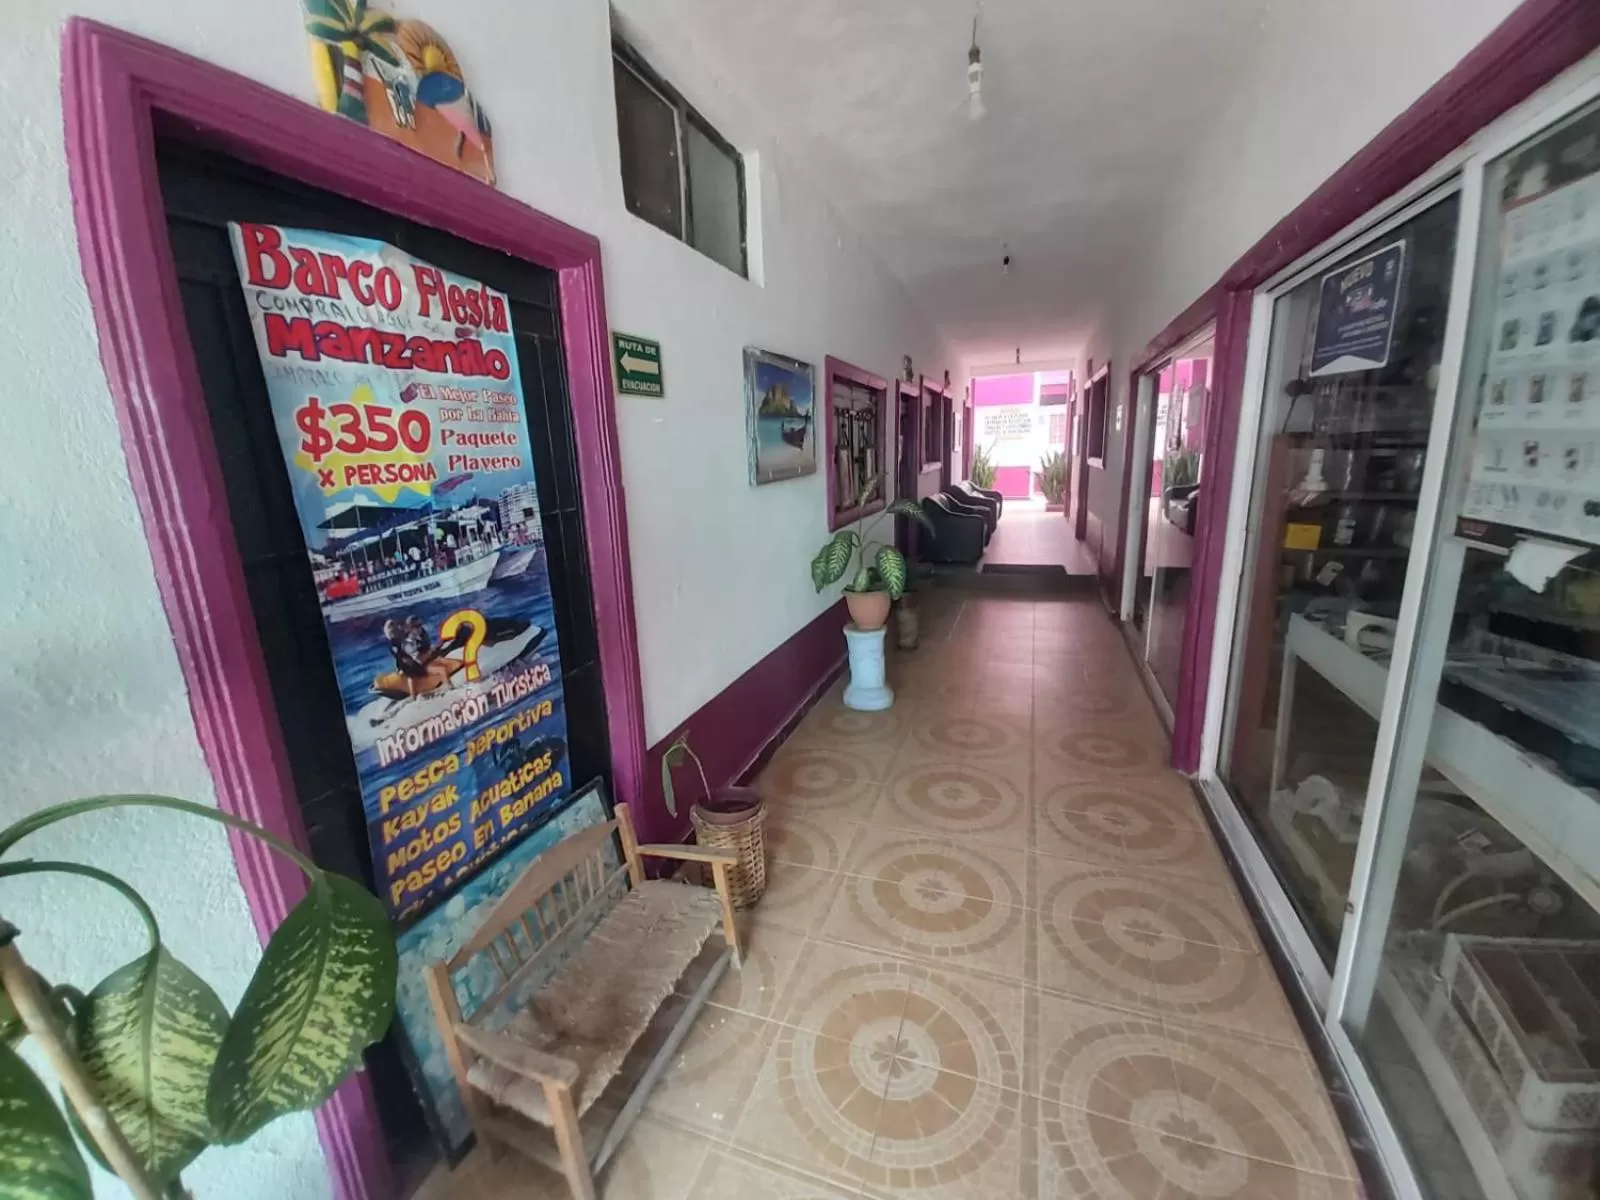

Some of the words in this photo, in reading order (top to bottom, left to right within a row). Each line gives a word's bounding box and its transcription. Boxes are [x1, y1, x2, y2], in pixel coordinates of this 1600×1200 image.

[240, 222, 402, 311] Barco
[618, 339, 643, 352] RUTA
[439, 386, 477, 403] Mejor
[440, 408, 463, 422] por
[295, 397, 431, 461] $350
[440, 428, 517, 448] Paquete
[344, 461, 437, 486] PERSONA
[448, 454, 521, 473] Playero
[379, 753, 460, 815] Pesca
[383, 785, 460, 846] Kayak
[388, 811, 462, 877] Motos
[391, 841, 467, 906] Paseo
[473, 818, 495, 851] En
[499, 771, 563, 828] Banana
